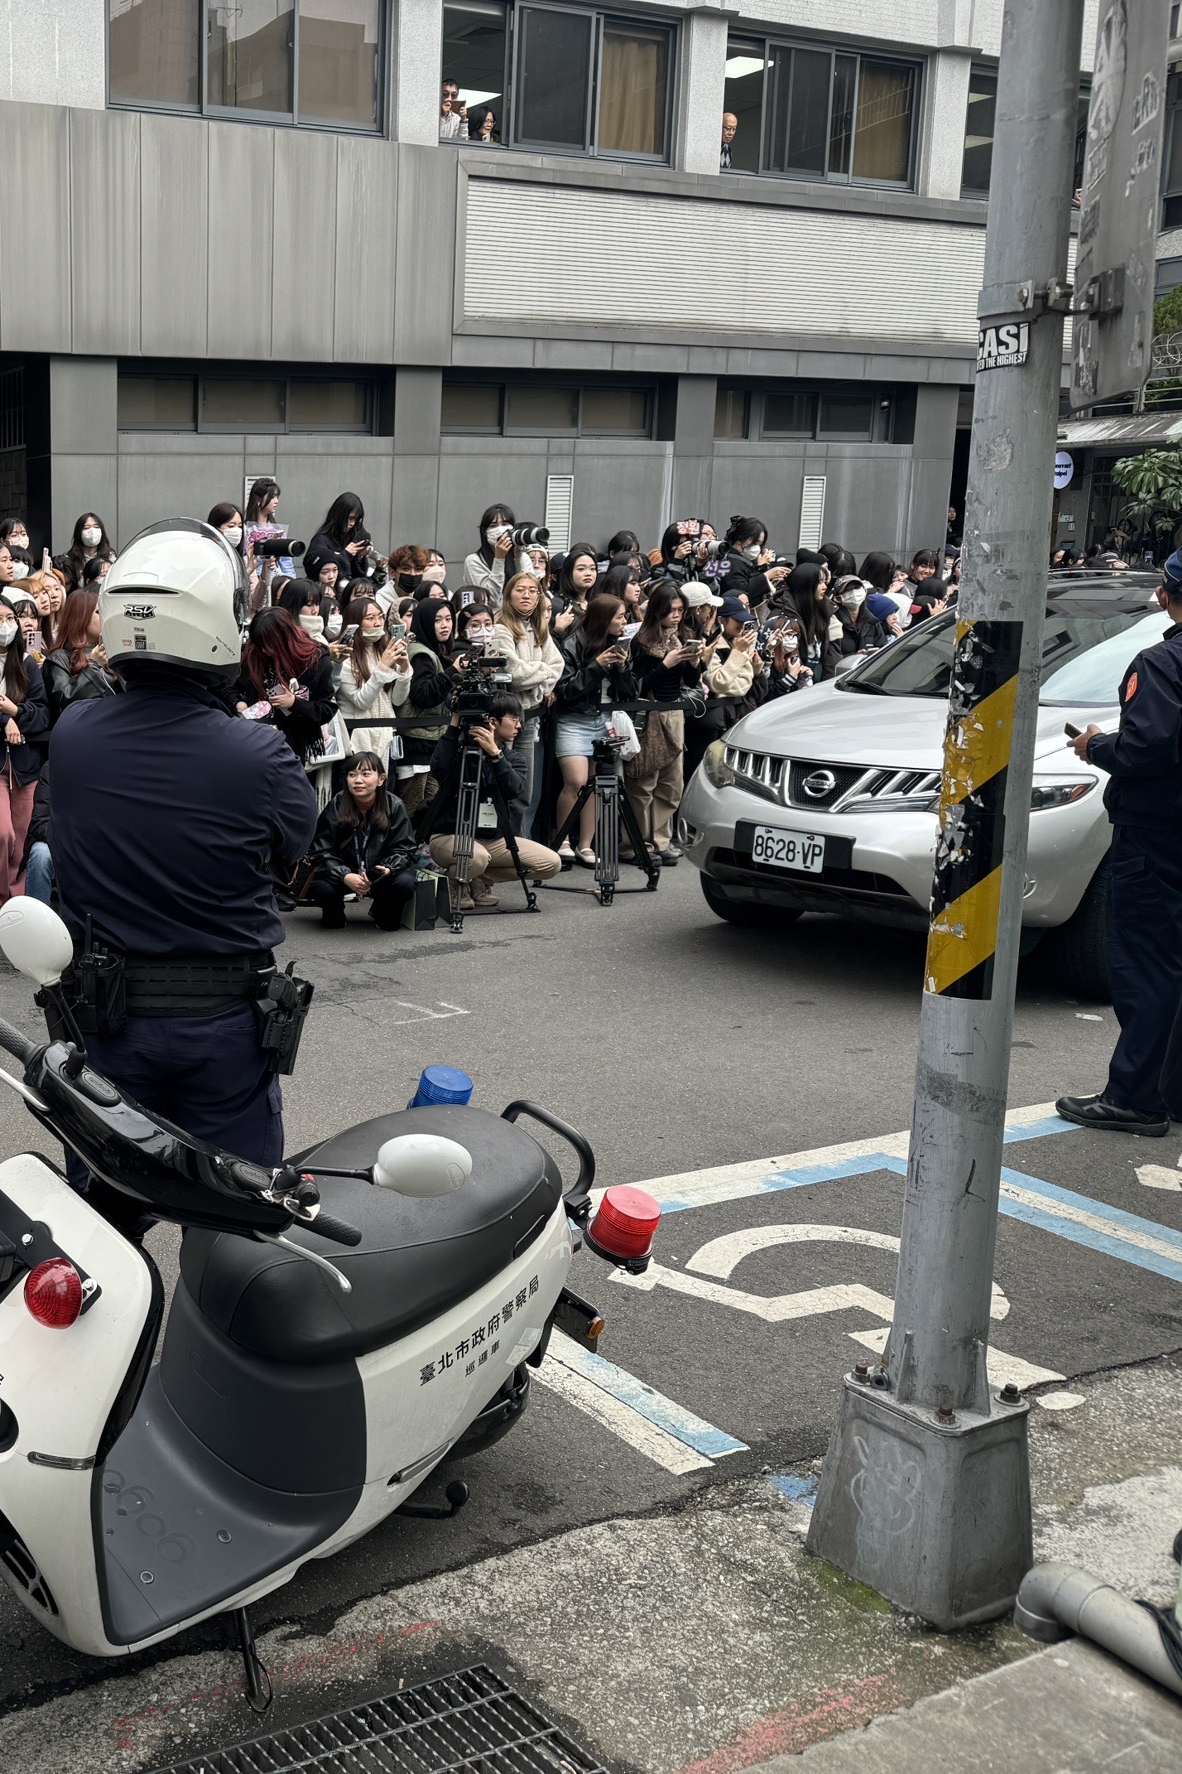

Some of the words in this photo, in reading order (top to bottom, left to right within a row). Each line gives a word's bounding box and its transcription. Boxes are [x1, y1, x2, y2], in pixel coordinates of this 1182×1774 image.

[986, 356, 996, 368] THE
[997, 352, 1028, 366] HIGHEST
[703, 559, 731, 577] 선우
[123, 603, 157, 614] RSV
[420, 1274, 539, 1387] 臺北市政府警察局
